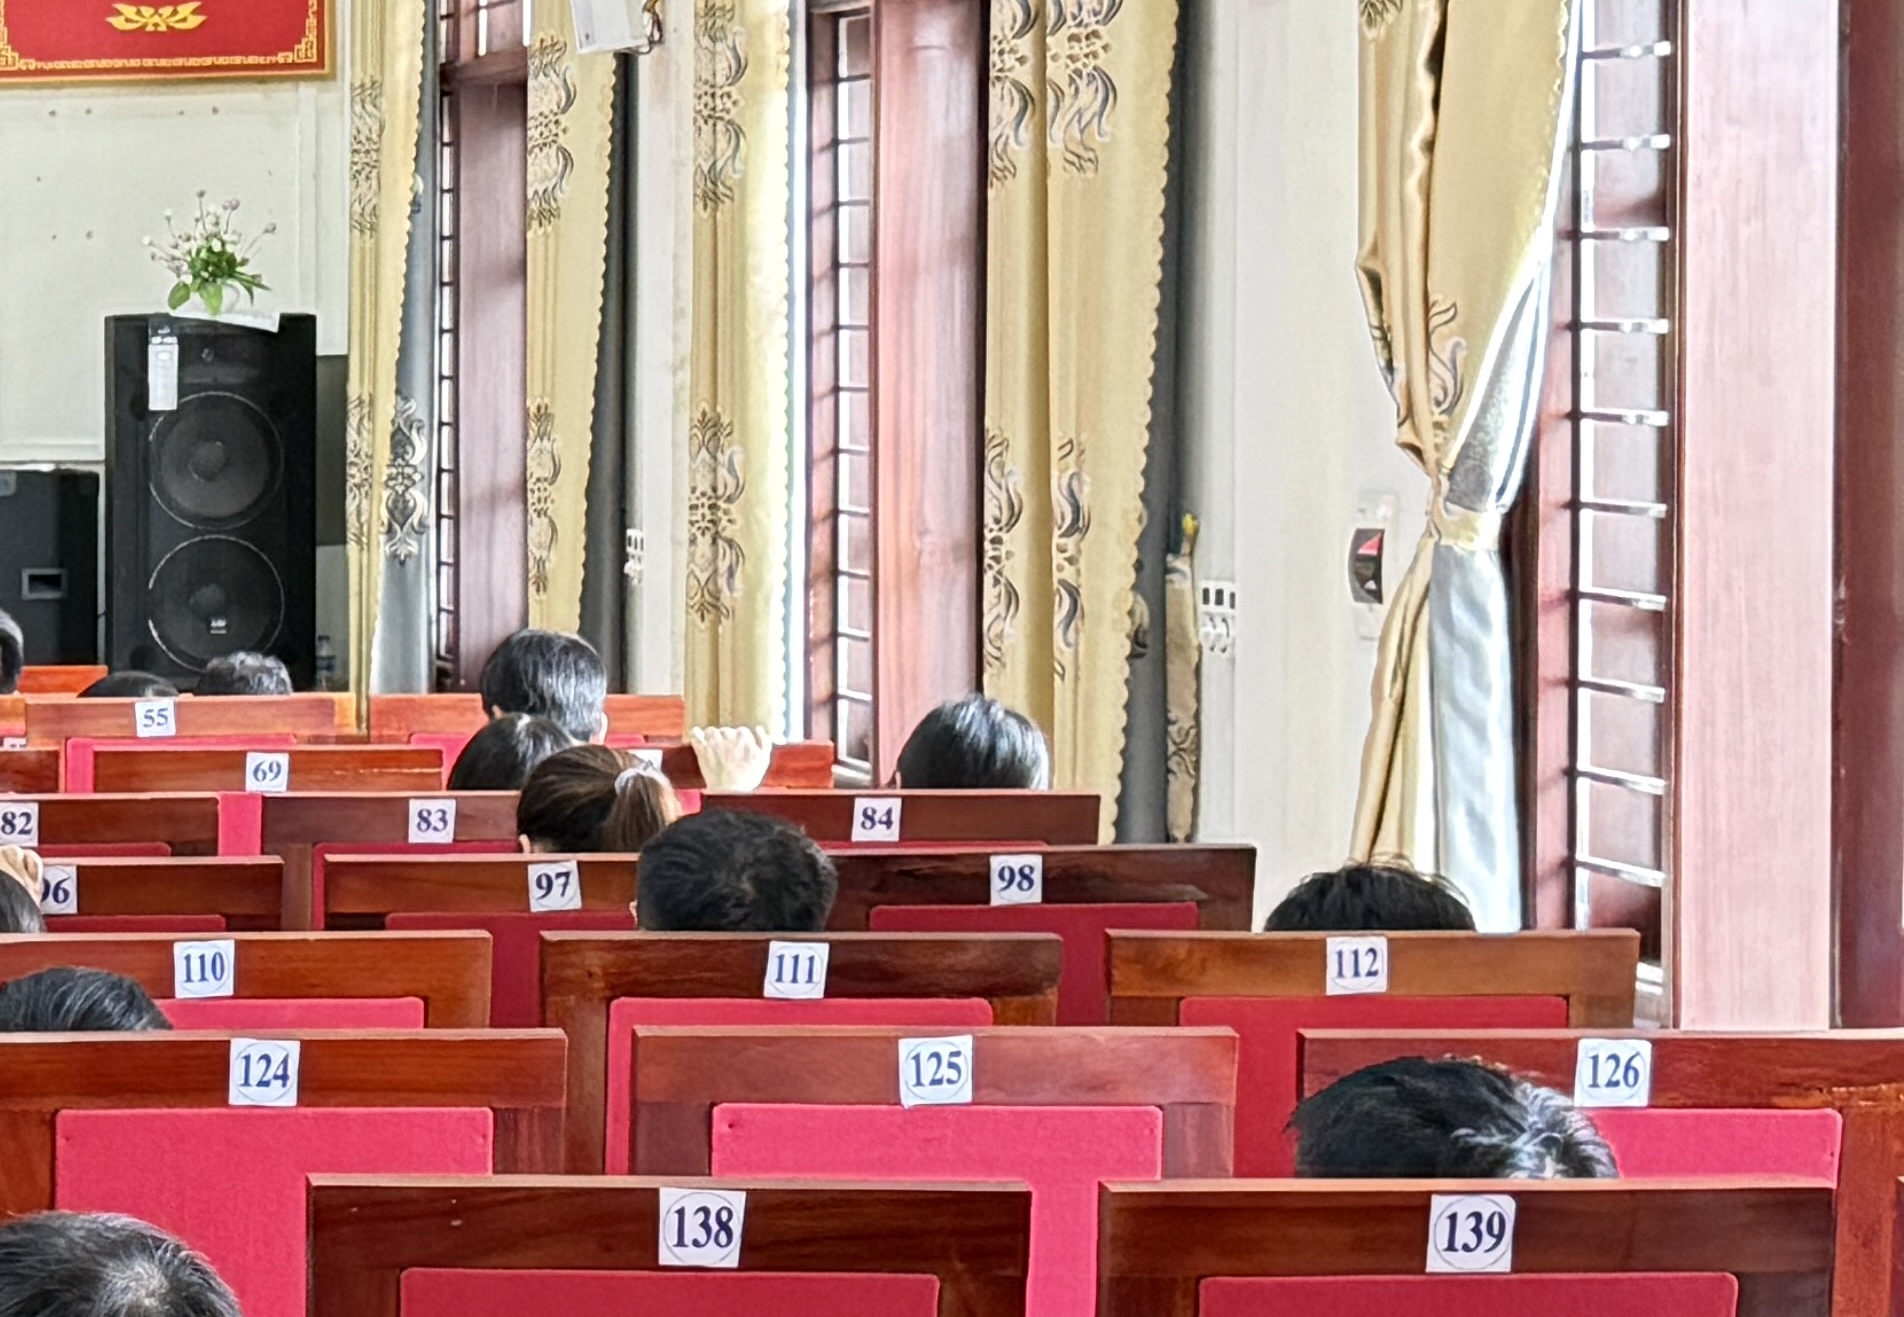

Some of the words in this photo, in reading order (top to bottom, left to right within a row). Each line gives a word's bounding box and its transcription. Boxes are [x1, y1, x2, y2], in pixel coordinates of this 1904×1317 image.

[144, 708, 168, 727] 55
[253, 762, 281, 781] 69
[1, 812, 32, 835] 82
[417, 809, 447, 831] 83
[861, 808, 893, 829] 84
[536, 871, 570, 899] 97
[998, 866, 1034, 891] 98
[185, 952, 224, 982] 110
[776, 955, 814, 983] 111
[1337, 948, 1378, 977] 112
[241, 1054, 289, 1088] 124
[912, 1051, 961, 1087] 125
[1589, 1052, 1640, 1088] 126
[673, 1206, 733, 1248] 138
[1444, 1212, 1505, 1252] 139
